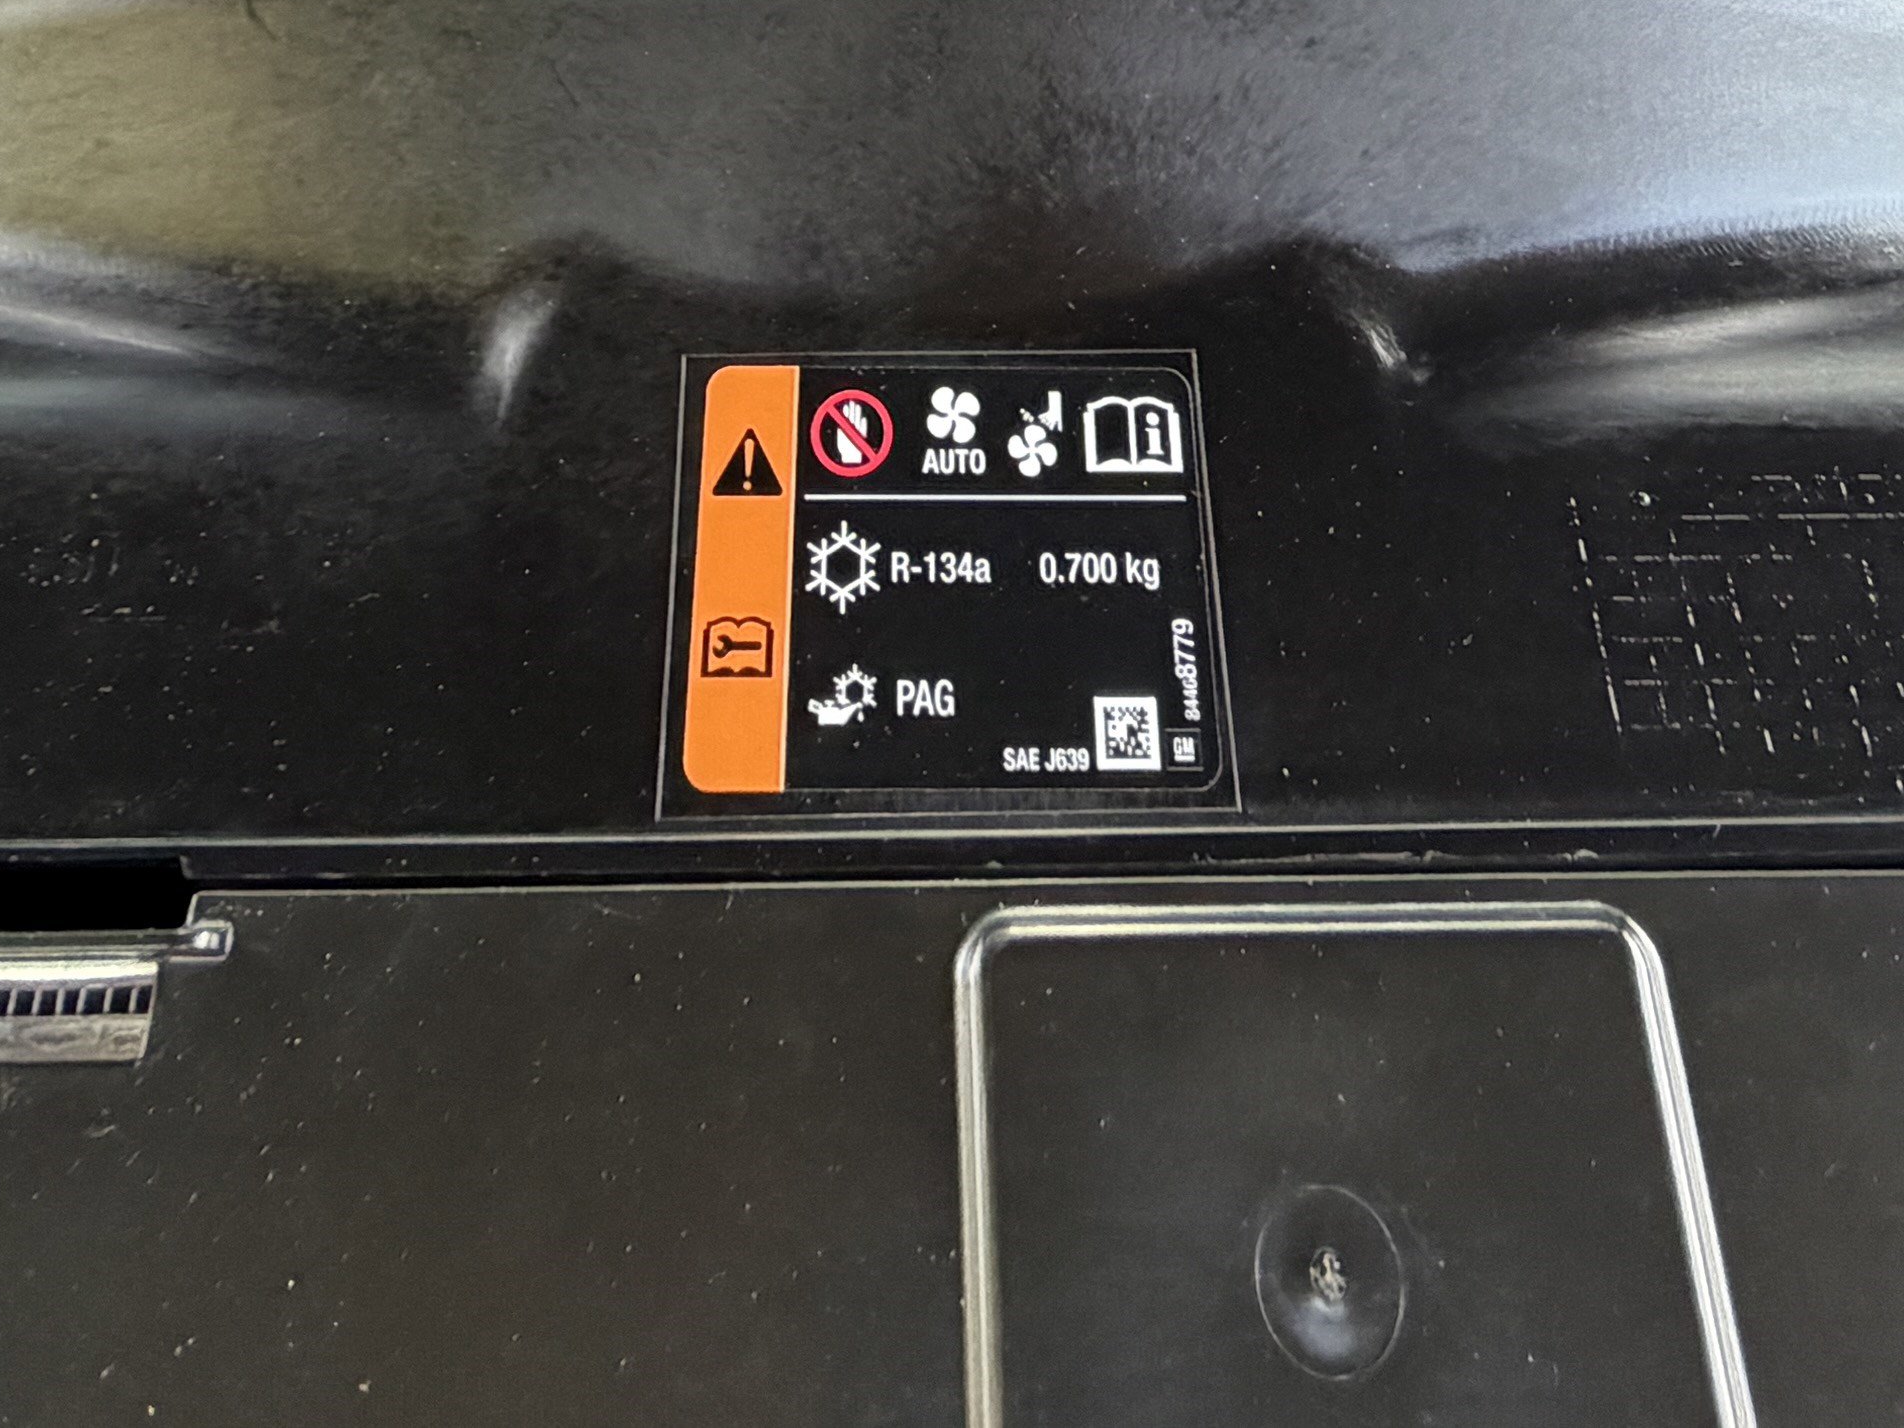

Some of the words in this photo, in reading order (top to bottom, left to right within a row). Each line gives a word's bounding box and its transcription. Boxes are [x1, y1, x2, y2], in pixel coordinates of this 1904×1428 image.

[922, 448, 986, 475] AUTO
[891, 553, 992, 584] R-134a
[1039, 554, 1118, 584] 0.700
[1125, 552, 1161, 591] kg
[896, 681, 956, 717] PAG
[1002, 748, 1040, 771] SAE
[1044, 748, 1090, 771] J639
[1173, 740, 1196, 764] GM
